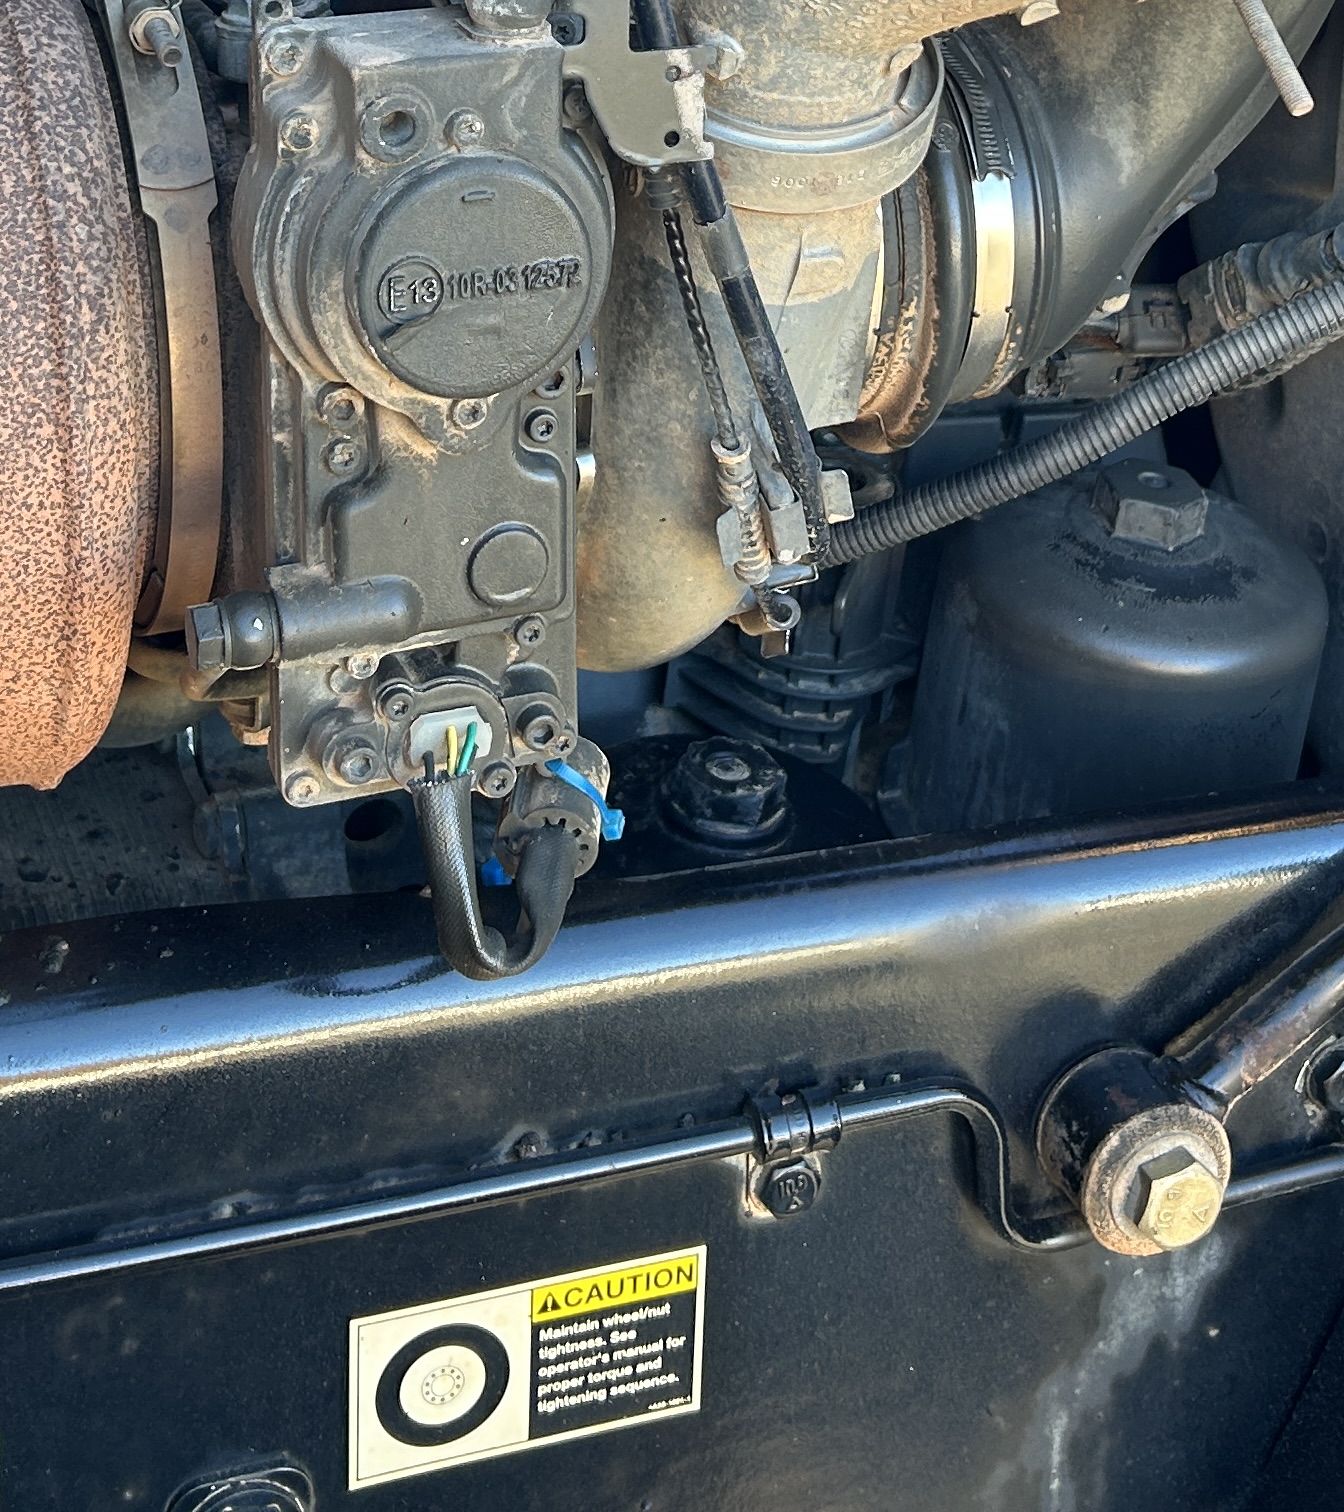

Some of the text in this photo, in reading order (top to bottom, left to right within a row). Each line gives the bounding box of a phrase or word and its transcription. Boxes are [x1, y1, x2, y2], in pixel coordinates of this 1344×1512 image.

[564, 1263, 694, 1308] CAUTION
[539, 1302, 671, 1342] Maintain wheel/nut
[538, 1329, 638, 1360] tightness. See
[538, 1335, 687, 1378] operator's manual for
[537, 1356, 663, 1397] proper torque and
[537, 1372, 680, 1413] tightening sequence.
